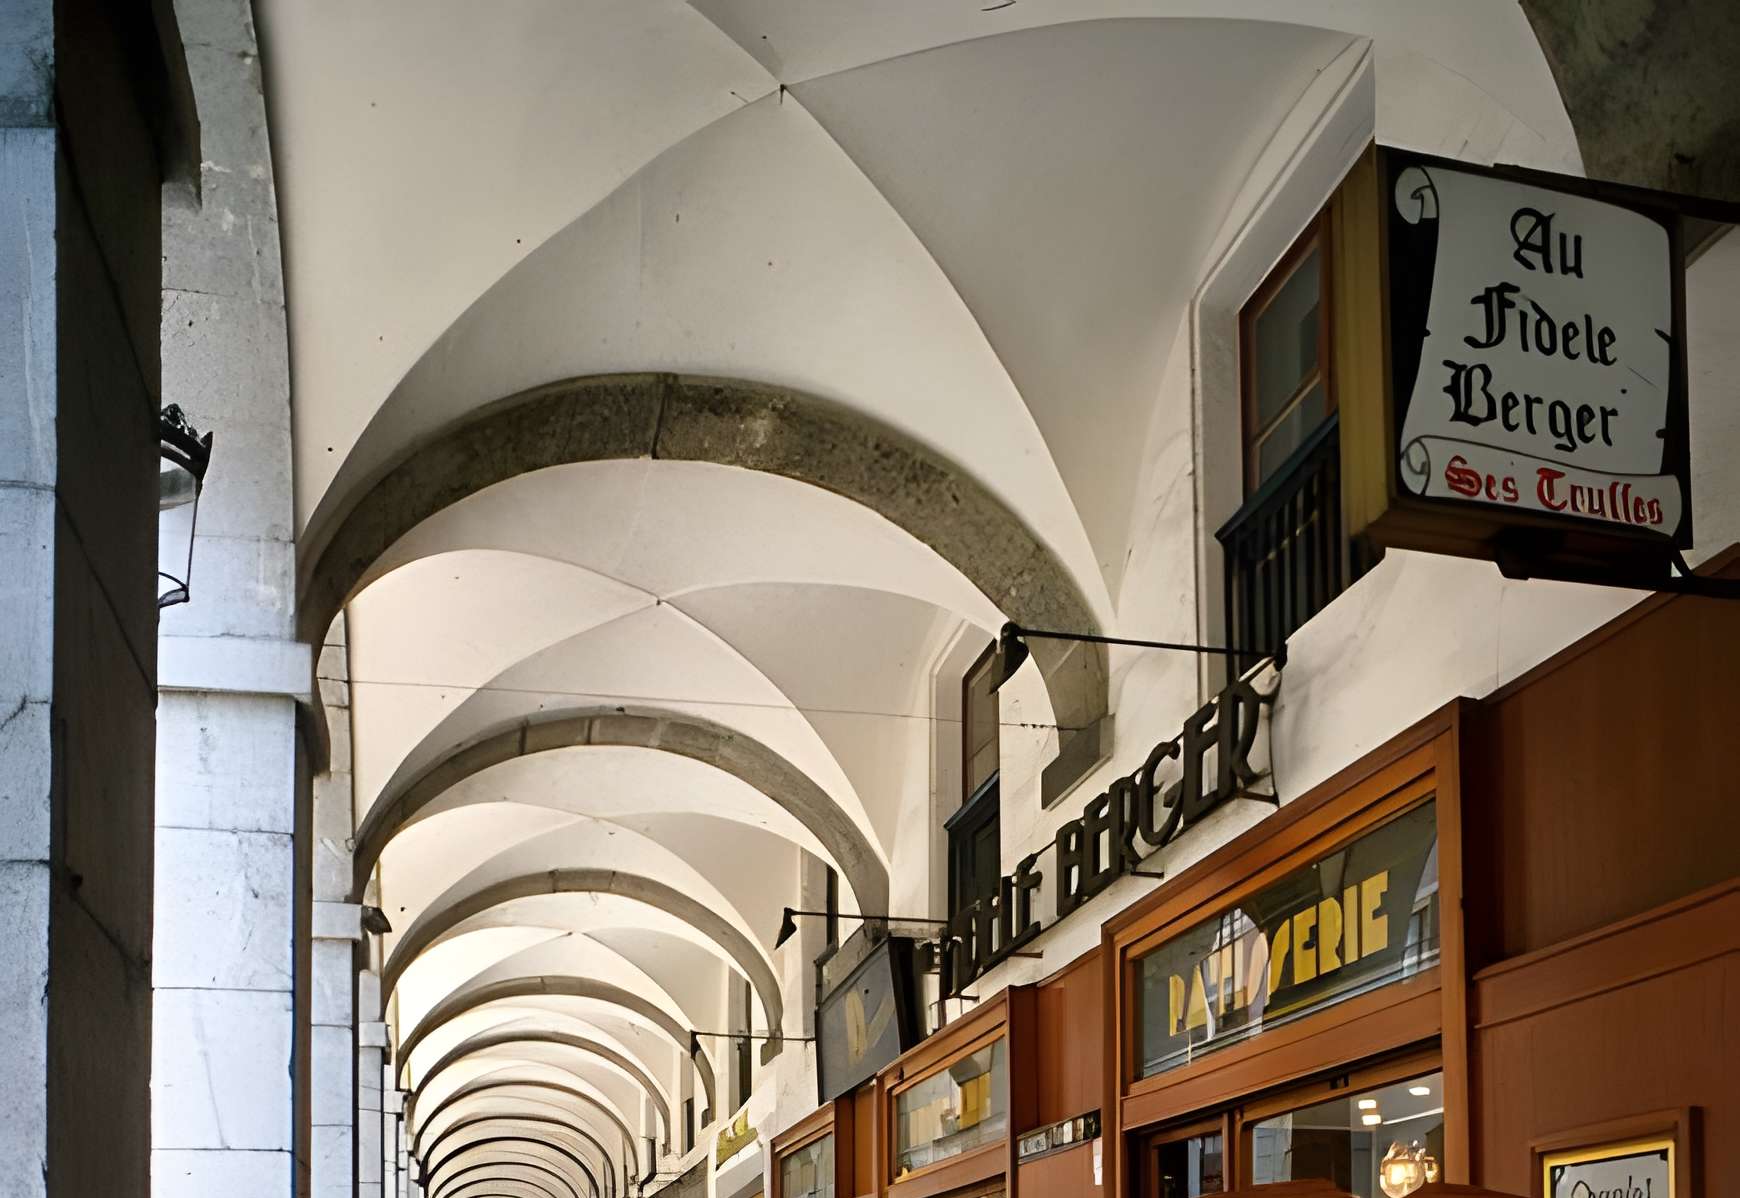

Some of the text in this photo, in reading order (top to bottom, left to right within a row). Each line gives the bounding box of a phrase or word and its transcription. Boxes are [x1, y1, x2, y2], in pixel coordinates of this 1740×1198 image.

[1510, 207, 1584, 279] Au
[1463, 281, 1618, 366] Fidele
[1442, 359, 1619, 451] Berger
[1056, 678, 1264, 917] BERGER
